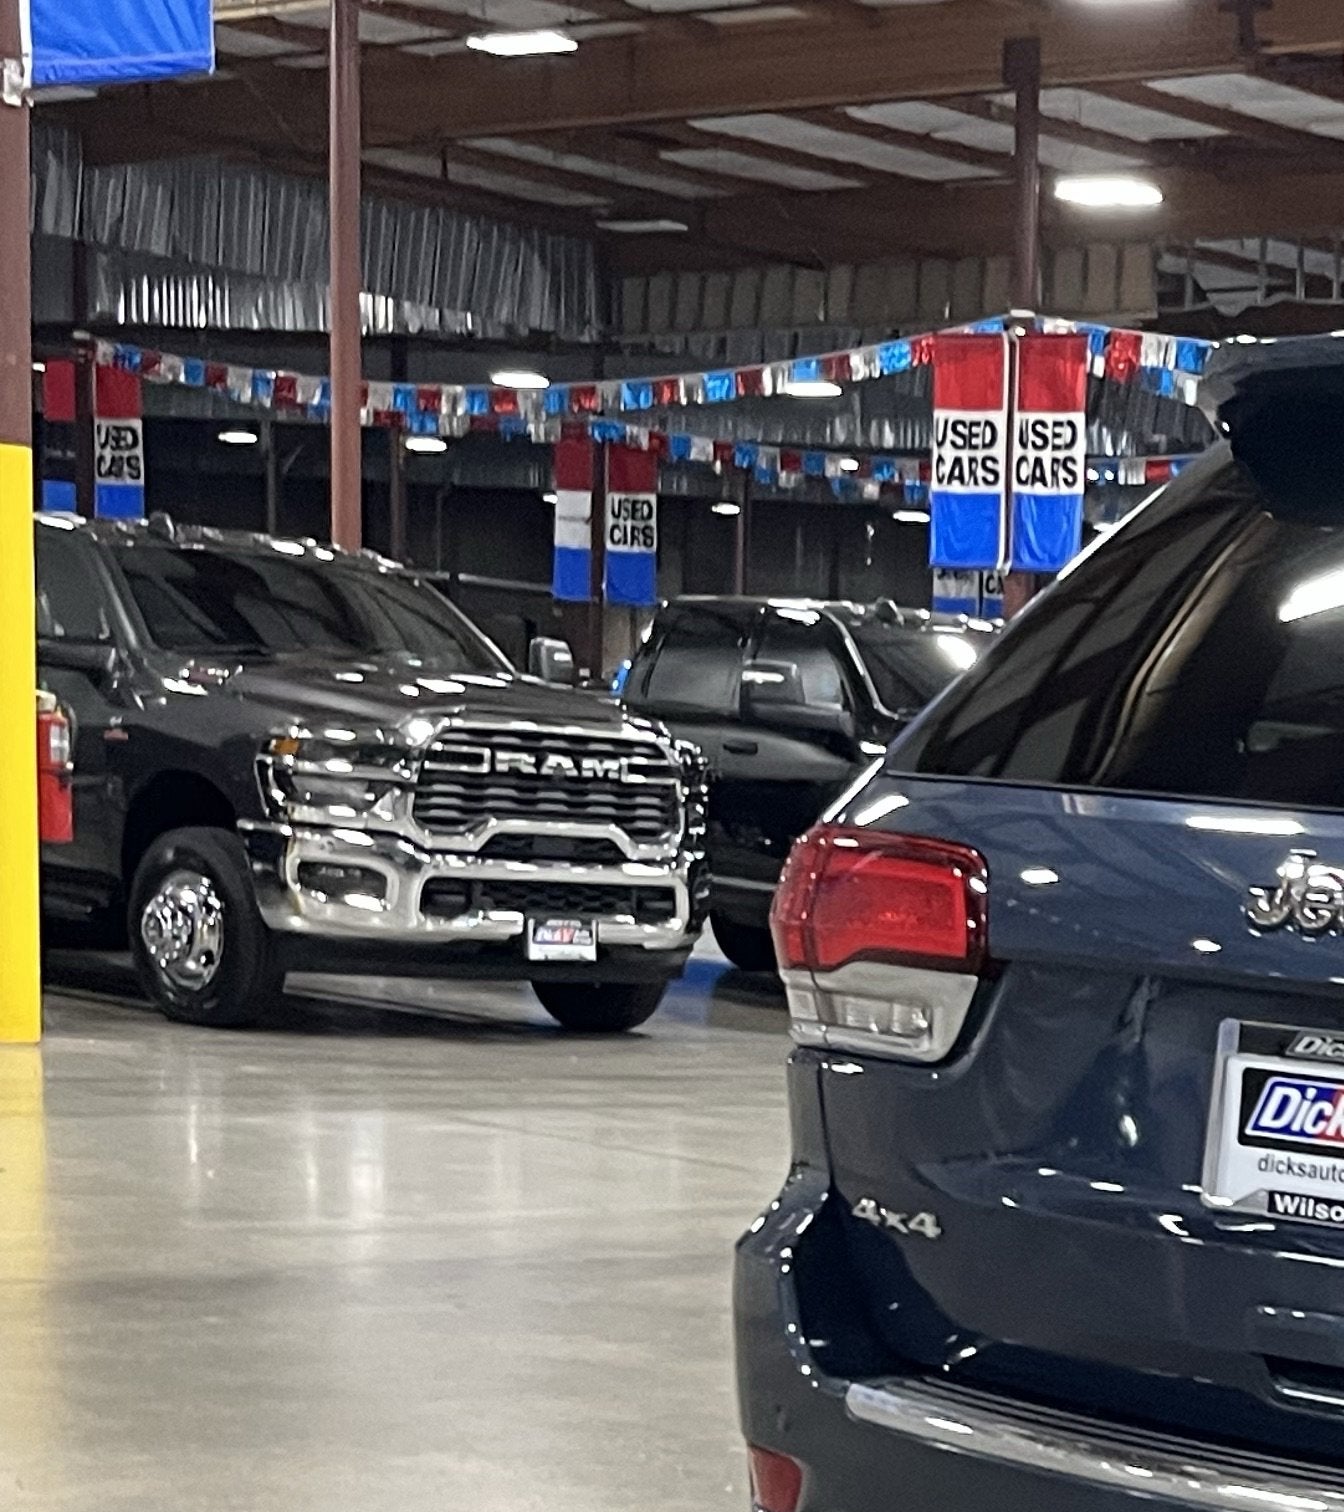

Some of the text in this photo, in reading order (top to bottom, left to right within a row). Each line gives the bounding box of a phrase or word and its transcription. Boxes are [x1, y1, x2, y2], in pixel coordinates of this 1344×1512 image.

[935, 418, 998, 450] USED
[1018, 419, 1078, 451] USED
[935, 454, 1000, 487] CARS
[1015, 455, 1078, 488] CARS
[611, 497, 653, 521] USED
[495, 751, 619, 778] RAM
